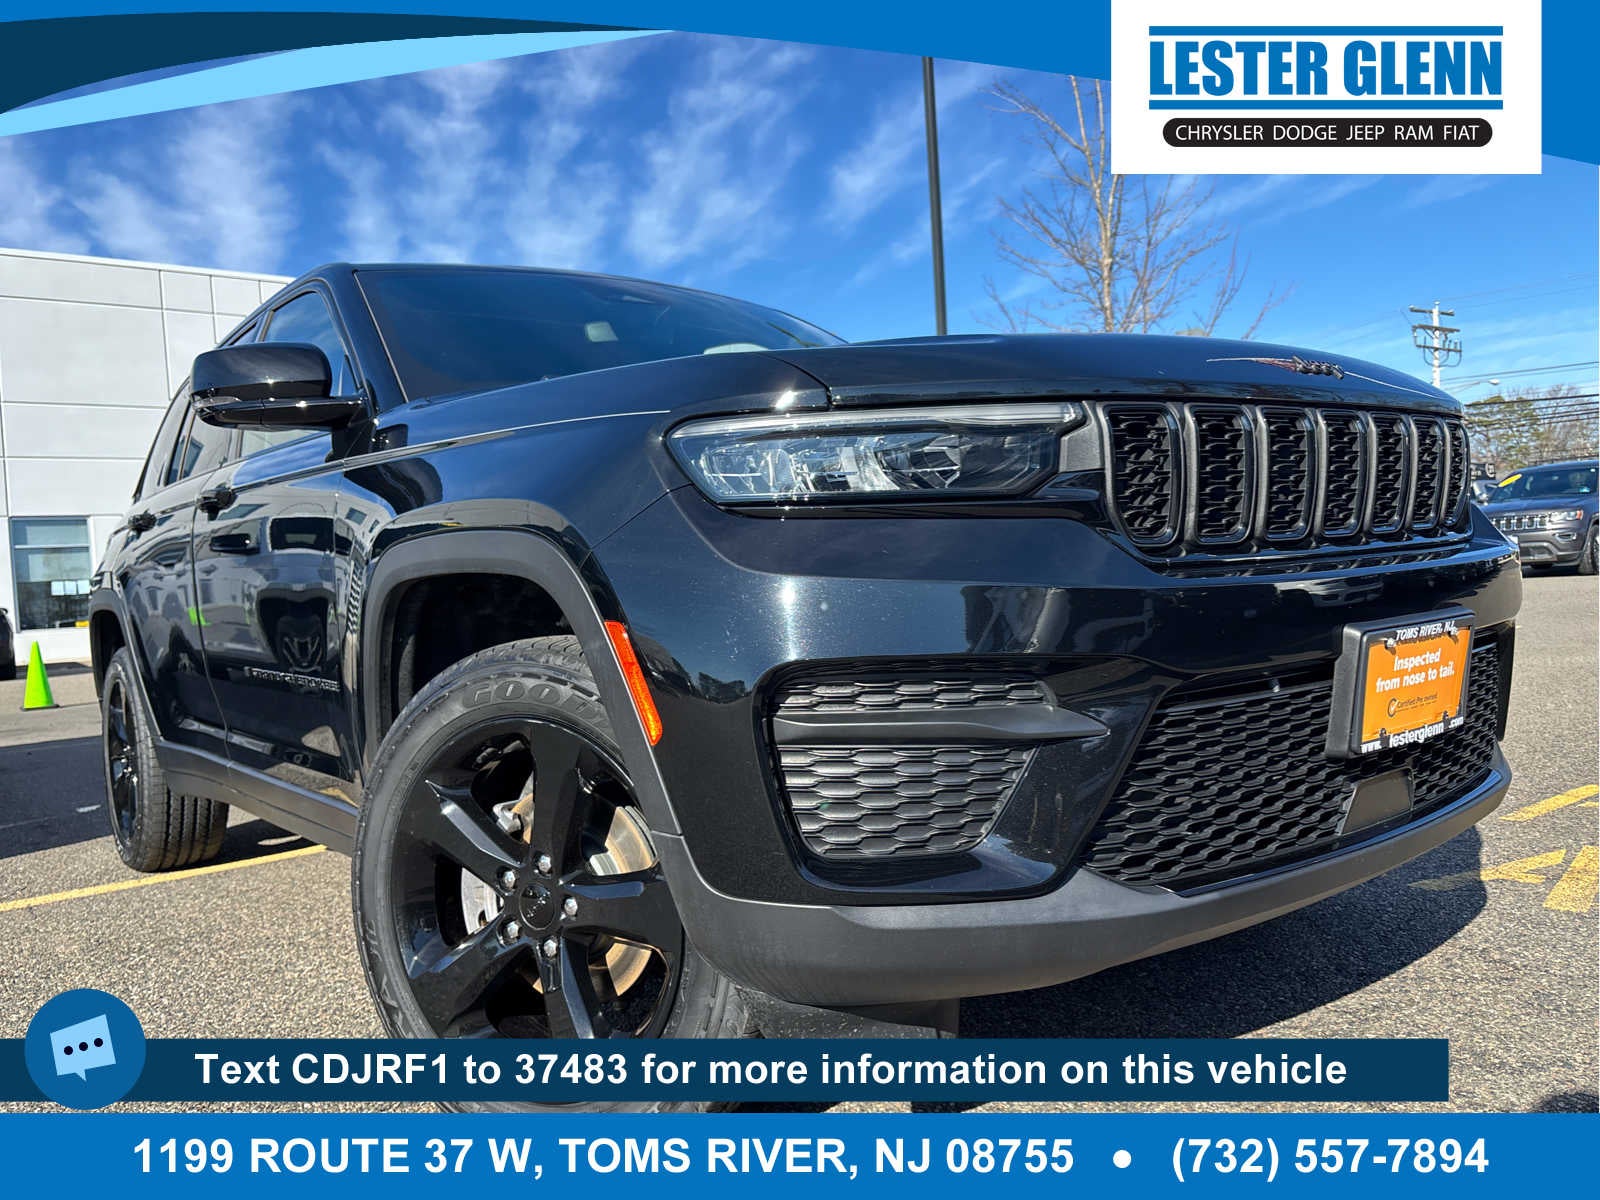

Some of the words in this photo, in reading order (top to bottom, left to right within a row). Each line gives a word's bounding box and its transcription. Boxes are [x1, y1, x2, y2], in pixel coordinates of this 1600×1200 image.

[1395, 627, 1419, 641] TOMS
[1393, 648, 1441, 671] Inspected
[1376, 676, 1400, 693] from
[1402, 672, 1425, 687] nose
[1427, 667, 1437, 680] to
[1439, 661, 1455, 678] tail.
[1388, 722, 1444, 748] lesterglenn
